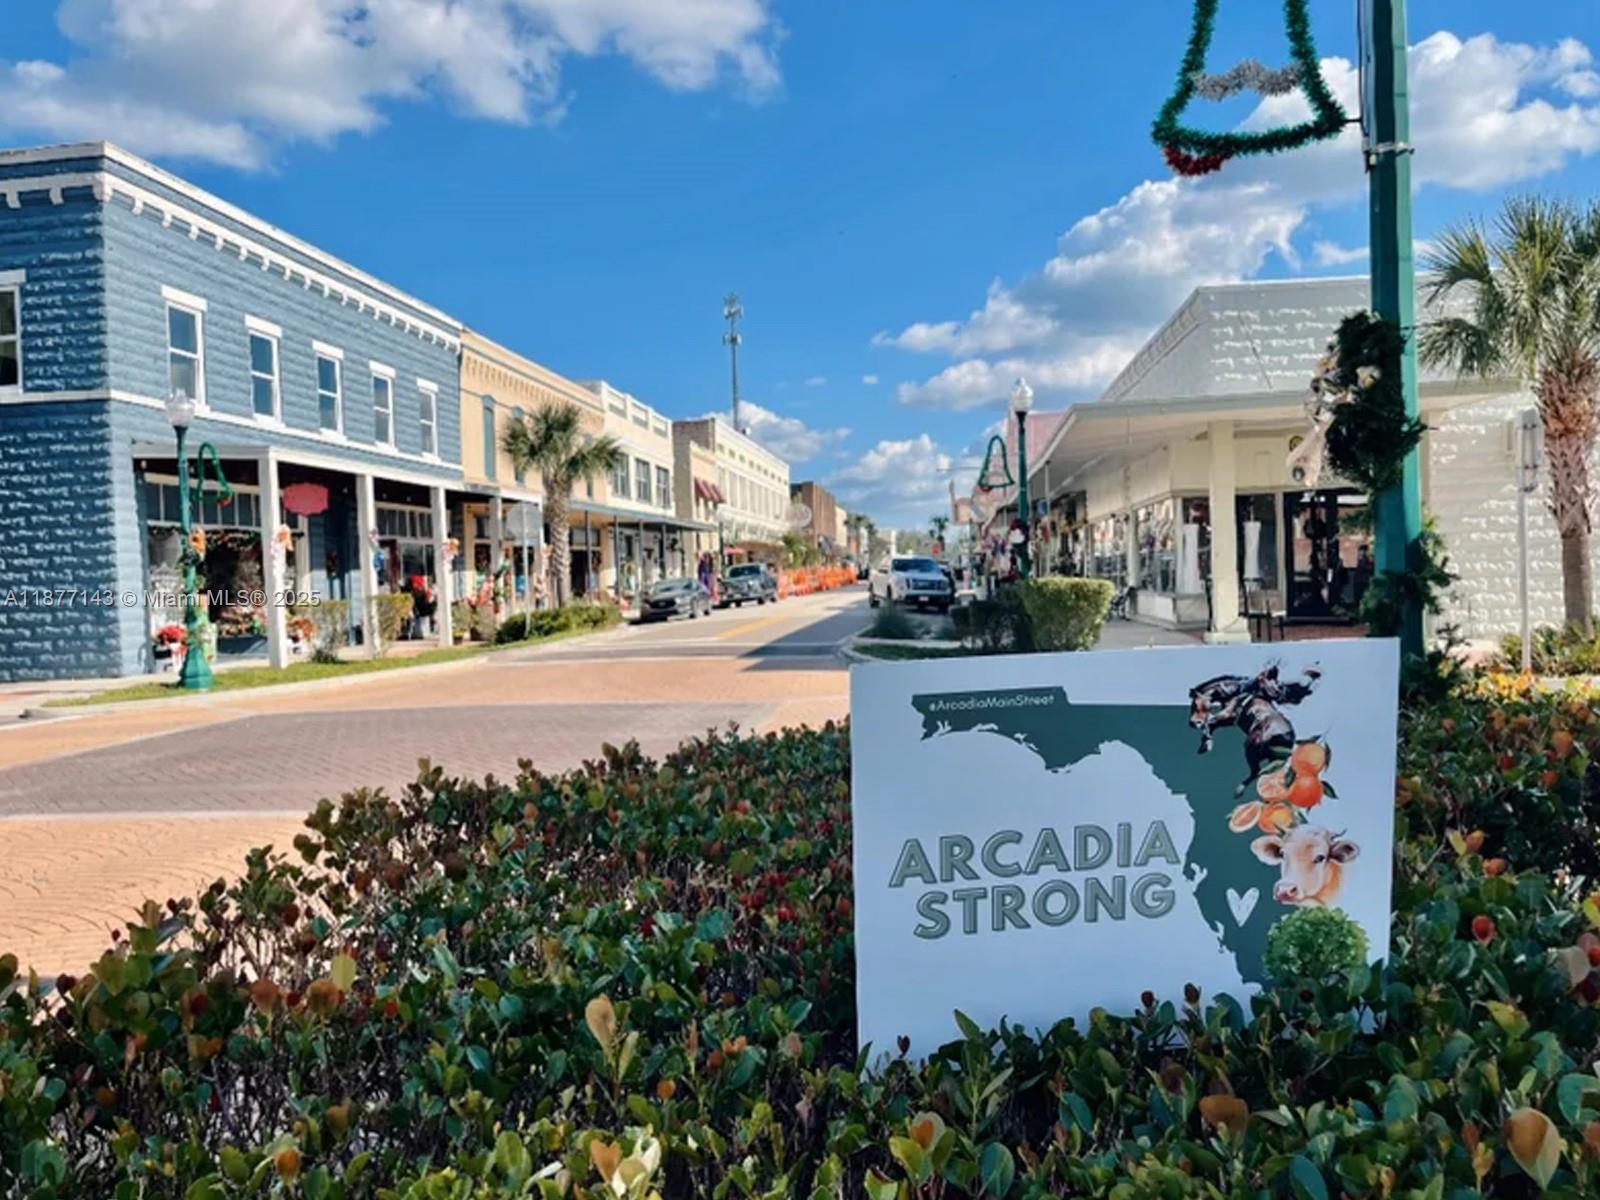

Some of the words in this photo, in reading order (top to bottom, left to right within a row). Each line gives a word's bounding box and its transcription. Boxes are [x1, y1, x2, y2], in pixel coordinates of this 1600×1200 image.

[929, 694, 1055, 712] #ArcadiaMainStreet
[888, 820, 1181, 887] ARCADIA
[913, 873, 1176, 939] STRONG
